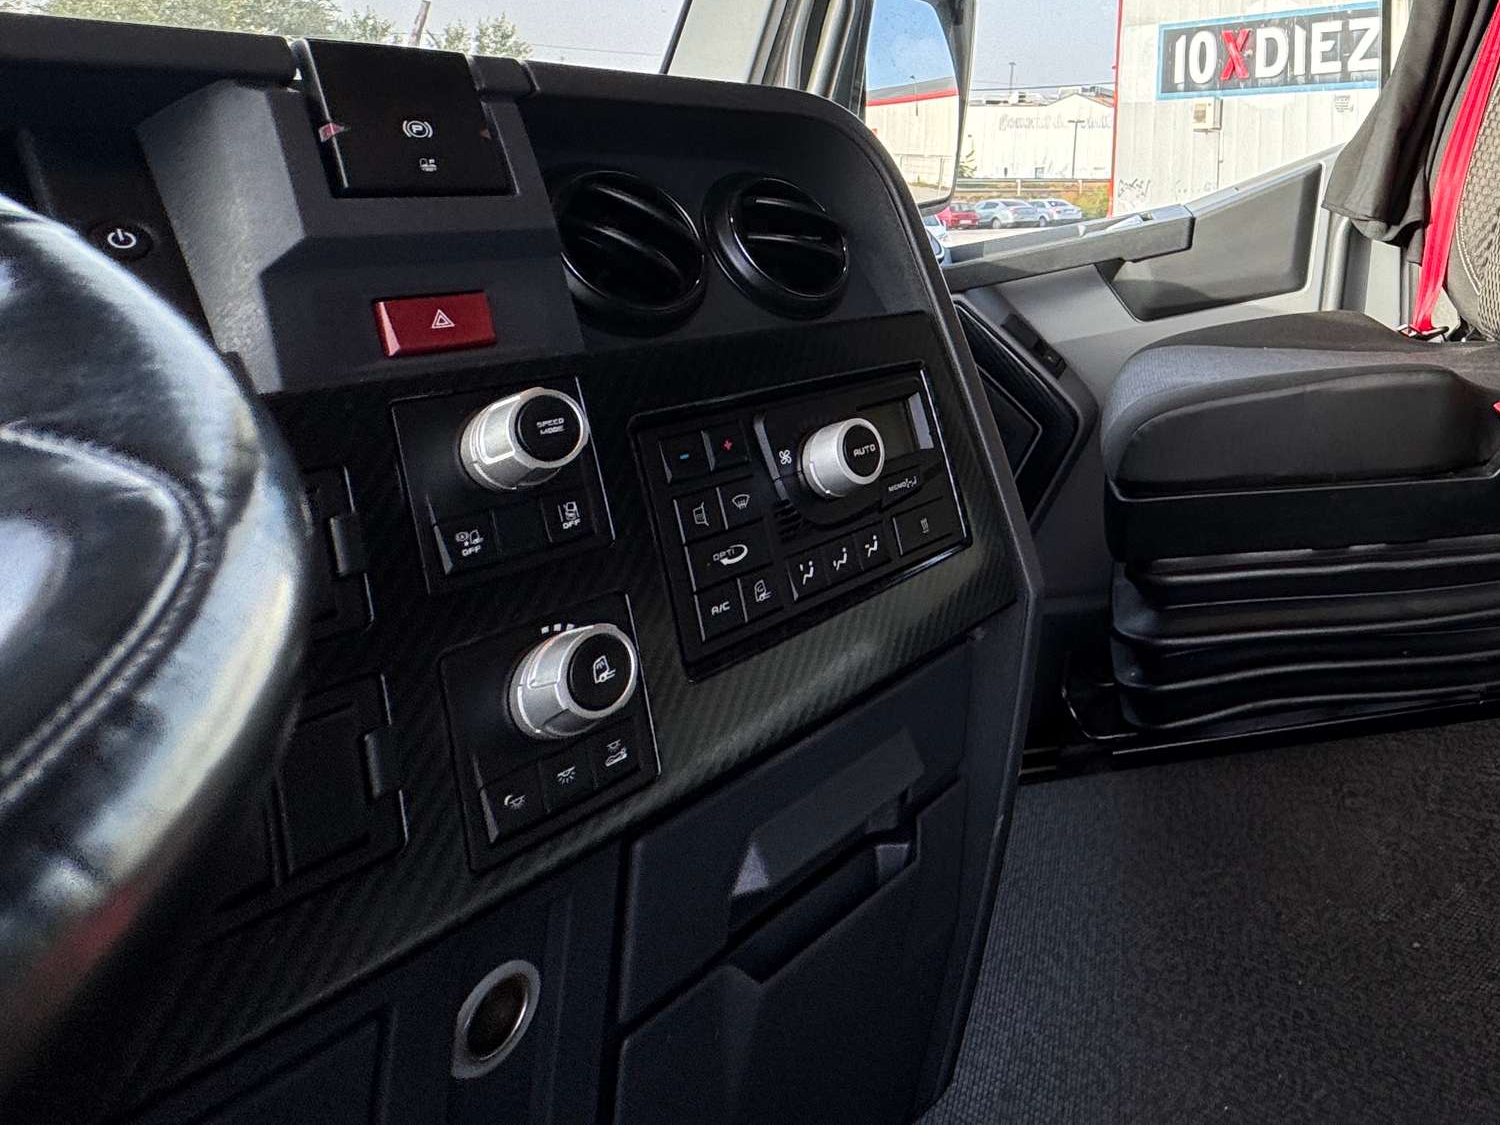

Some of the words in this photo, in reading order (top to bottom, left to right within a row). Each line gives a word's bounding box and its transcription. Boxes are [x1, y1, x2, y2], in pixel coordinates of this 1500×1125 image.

[536, 417, 565, 428] SPEED
[540, 425, 565, 435] MODE
[853, 443, 876, 457] AUTO
[562, 518, 580, 530] OFF
[461, 545, 481, 557] OFF
[712, 548, 735, 561] OPTI
[711, 601, 731, 616] A/C
